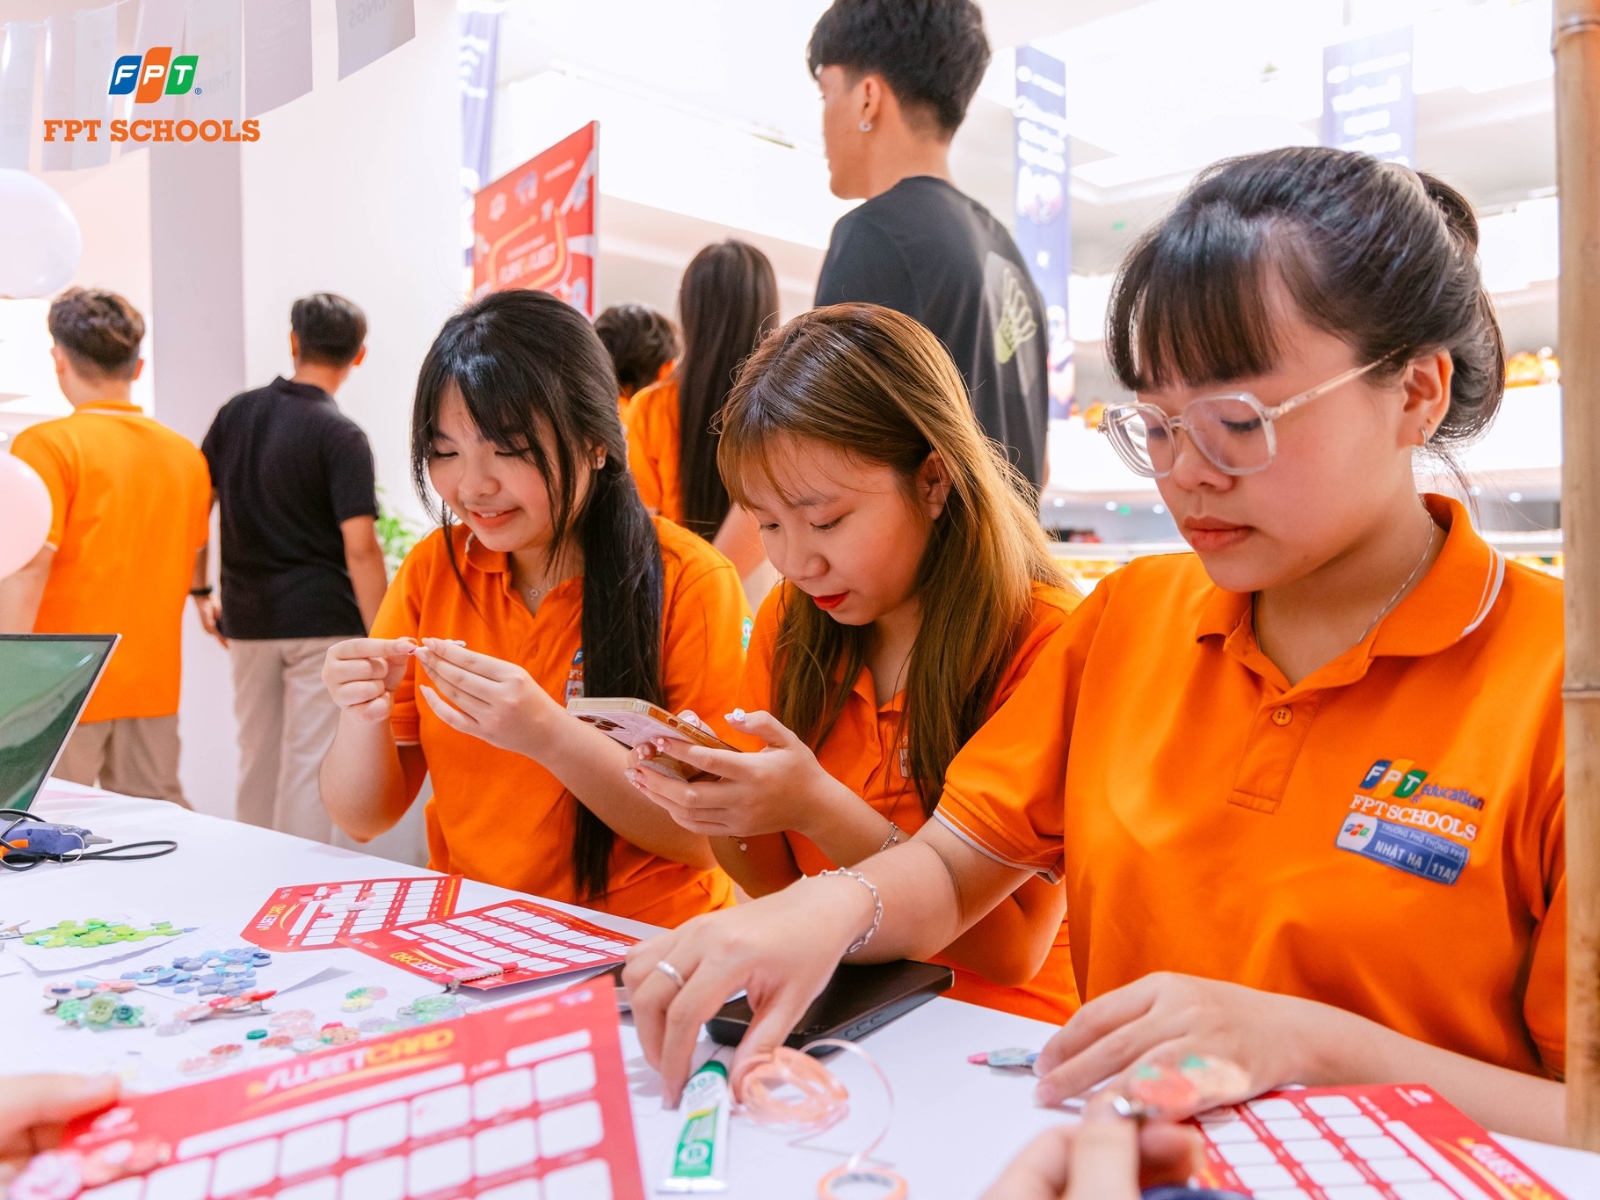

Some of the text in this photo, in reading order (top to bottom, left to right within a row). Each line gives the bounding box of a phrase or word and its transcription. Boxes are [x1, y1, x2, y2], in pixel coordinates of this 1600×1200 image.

[1421, 784, 1485, 811] Education
[1349, 794, 1478, 842] FPT SCHOOLS
